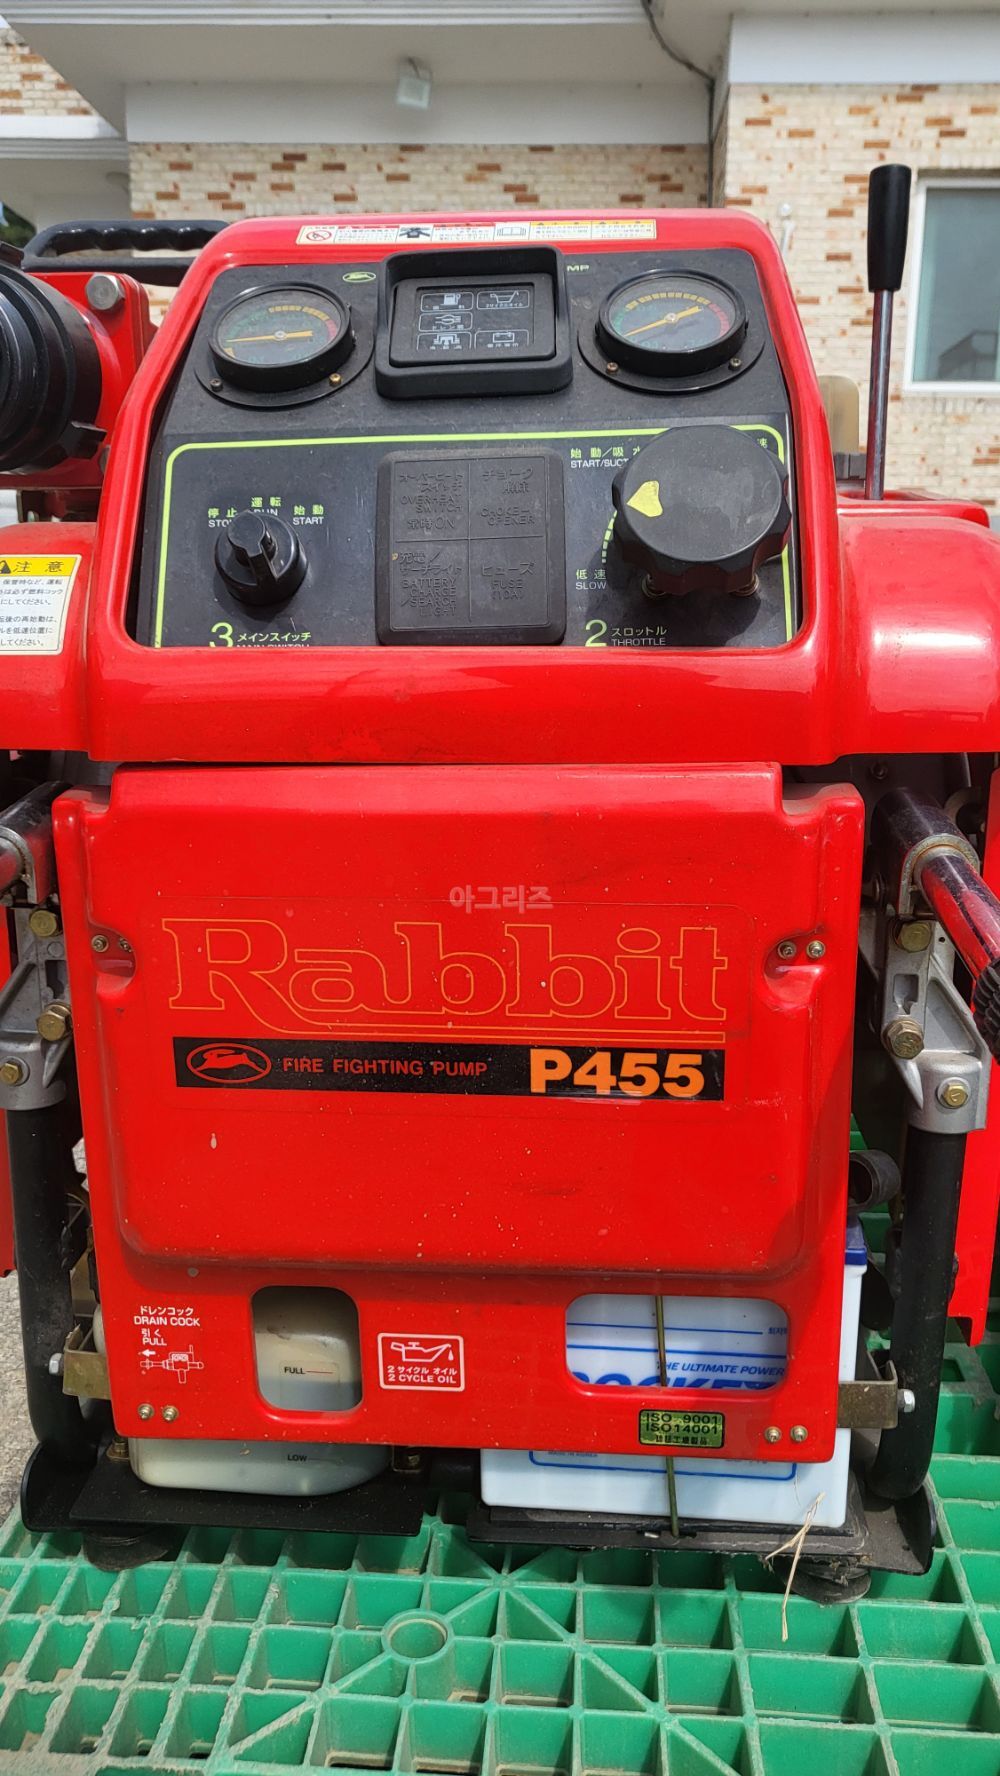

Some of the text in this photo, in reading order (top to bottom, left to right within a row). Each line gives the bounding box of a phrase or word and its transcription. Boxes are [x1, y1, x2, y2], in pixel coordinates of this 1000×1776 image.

[294, 505, 324, 516] 始動
[208, 520, 233, 528] STO
[292, 517, 324, 525] START
[403, 577, 456, 588] BATTERY
[575, 581, 606, 590] SLOW
[410, 587, 456, 598] CHARGE
[237, 632, 311, 642] メインスイッチ
[585, 619, 607, 647] 2
[611, 626, 667, 637] スロットル
[611, 637, 667, 647] THROTTLE
[161, 917, 728, 1044] Rabbit
[282, 1048, 705, 1099] FIRE FIGHTING PUMP P455
[140, 1305, 194, 1316] ドレンコック
[133, 1316, 201, 1327] DRAIN COCK
[142, 1337, 168, 1346] PULL
[284, 1366, 306, 1375] FULL
[387, 1365, 458, 1376] 2 サイクル オイル
[681, 1361, 738, 1374] ULTIMATE
[740, 1366, 785, 1376] POWER
[388, 1374, 457, 1384] 2 CYCLE OIL
[646, 1413, 718, 1425] ISO 9001
[287, 1454, 307, 1462] LOW
